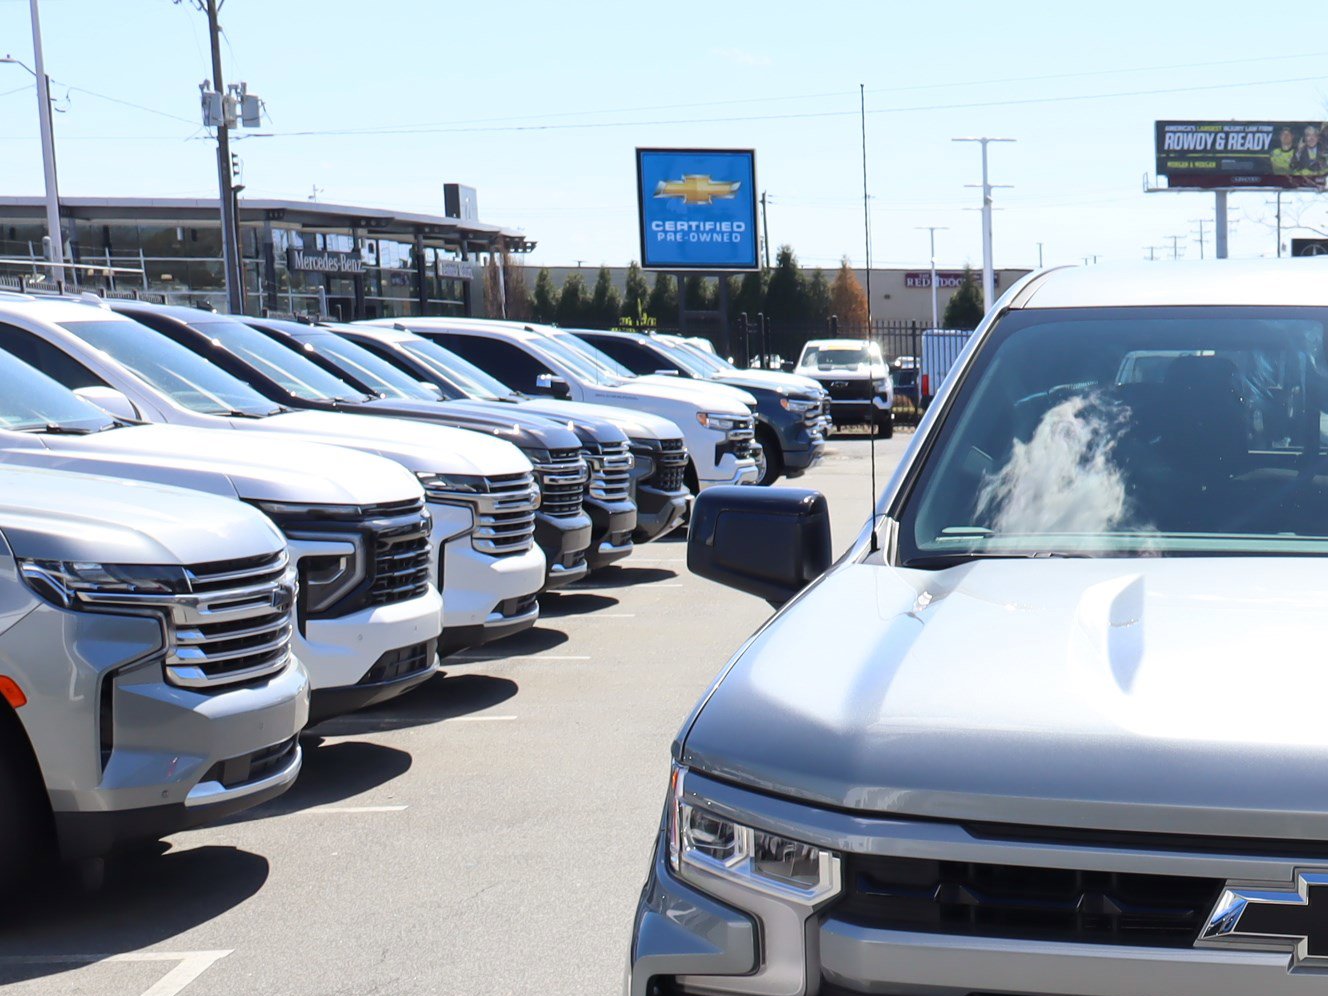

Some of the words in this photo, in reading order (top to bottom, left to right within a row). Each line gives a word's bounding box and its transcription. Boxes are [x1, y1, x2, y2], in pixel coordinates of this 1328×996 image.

[1164, 132, 1215, 150] ROWDY
[1227, 132, 1273, 150] READY
[651, 221, 746, 232] CERTIFIED
[657, 232, 741, 242] PRE-OWNED
[294, 251, 363, 272] Mercedes-Benz
[906, 278, 931, 288] RED
